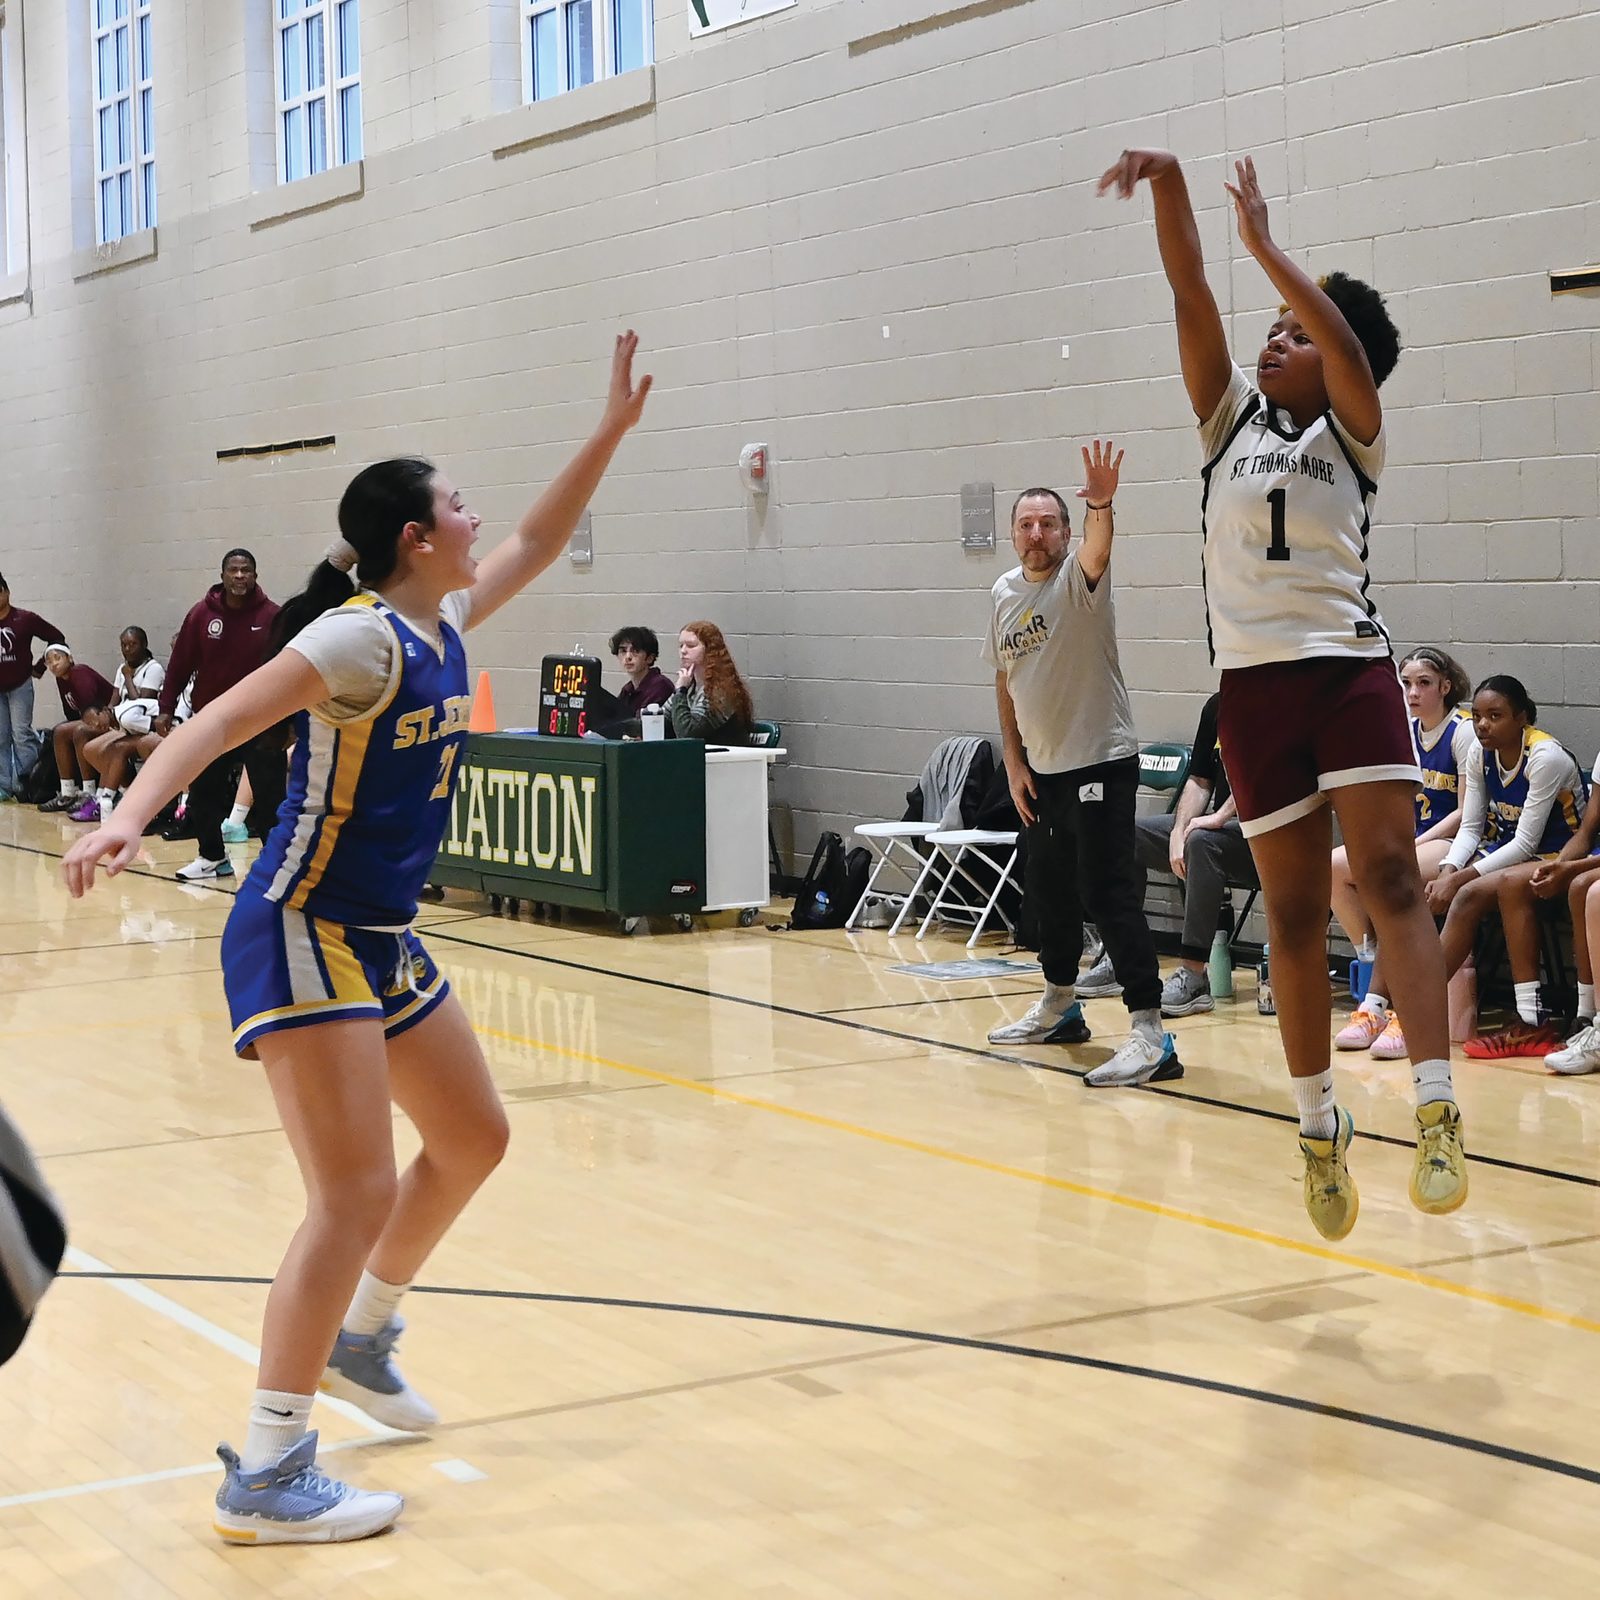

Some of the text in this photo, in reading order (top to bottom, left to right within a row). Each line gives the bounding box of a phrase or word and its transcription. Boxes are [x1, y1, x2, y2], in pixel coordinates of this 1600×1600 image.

[1230, 452, 1335, 486] ST. THOMAS MORE
[1266, 488, 1290, 561] 1
[553, 664, 584, 695] 0:02
[437, 764, 597, 876] TATION
[1415, 792, 1432, 821] 2
